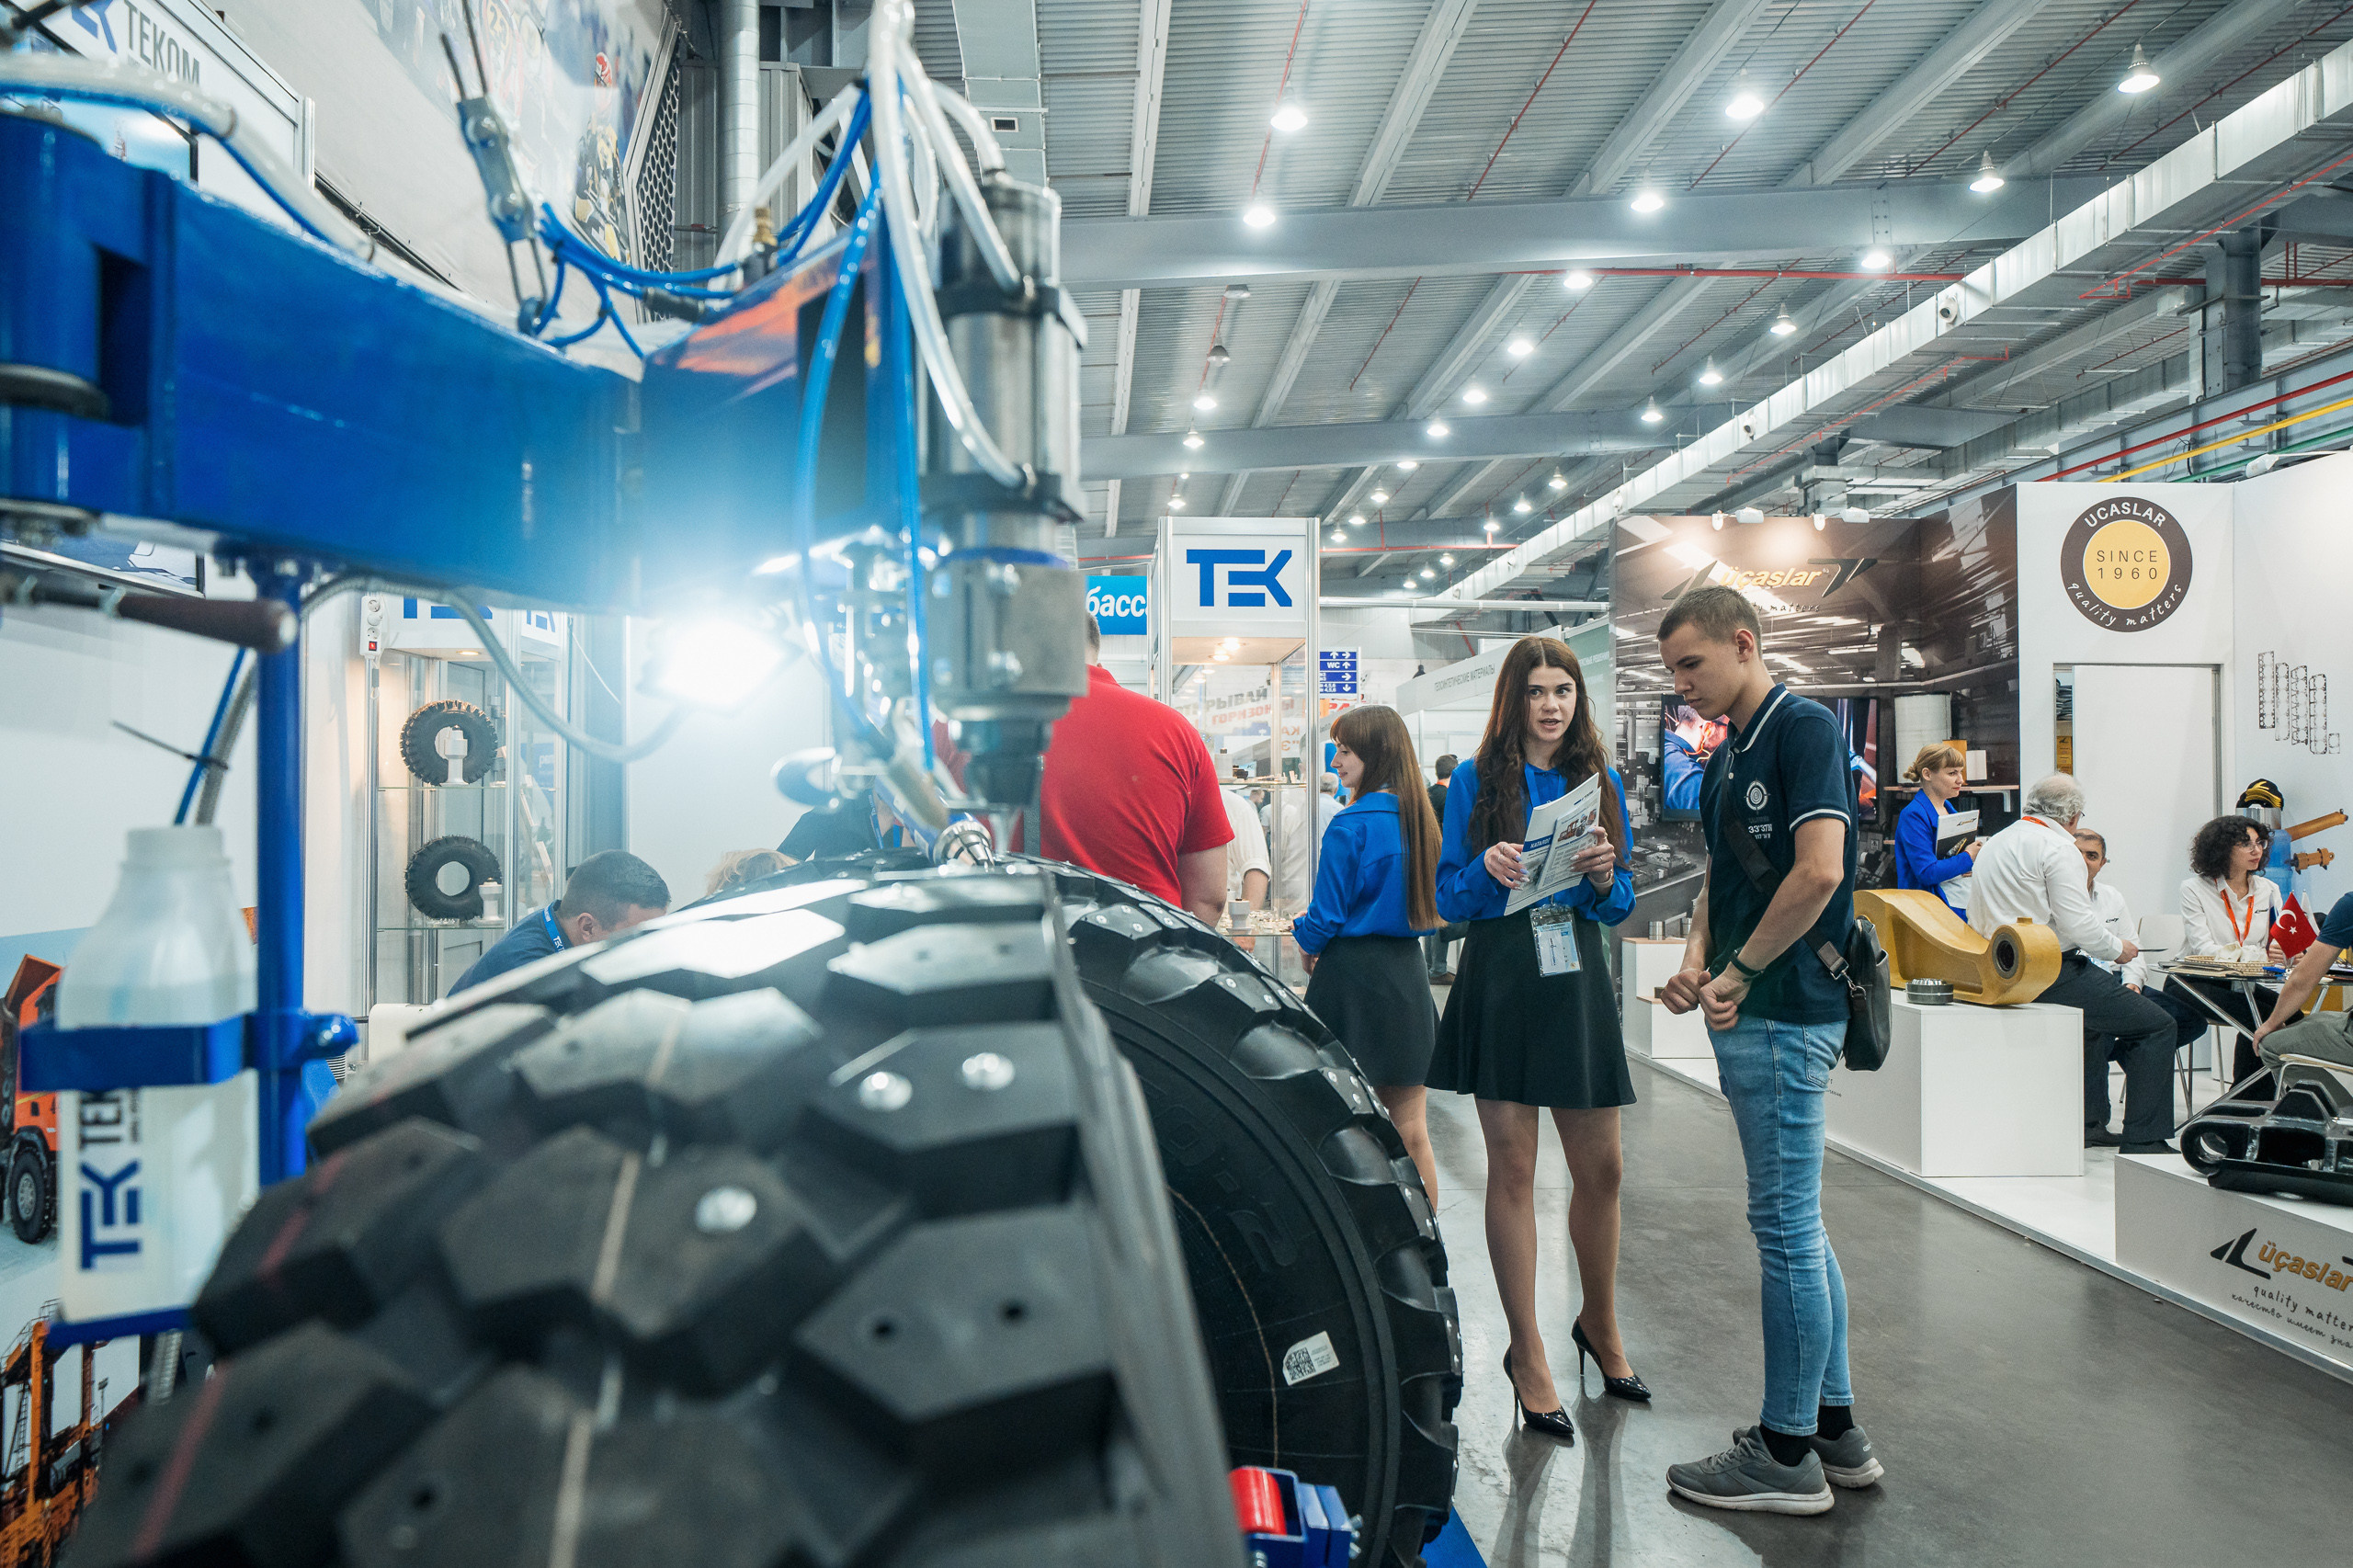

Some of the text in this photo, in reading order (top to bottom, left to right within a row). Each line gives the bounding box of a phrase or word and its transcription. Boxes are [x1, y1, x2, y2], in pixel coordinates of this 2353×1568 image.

[2084, 501, 2166, 528] UCASLAR
[2097, 550, 2158, 562] SINCE
[2097, 567, 2158, 580] 1960
[1186, 549, 1292, 608] TEK
[1086, 585, 1148, 618] басс
[1770, 602, 1821, 613] matters
[2068, 583, 2182, 627] quality matters
[79, 1156, 141, 1270] TEK
[2232, 1293, 2353, 1349] качество имеет зна
[2253, 1286, 2353, 1332] quality matter
